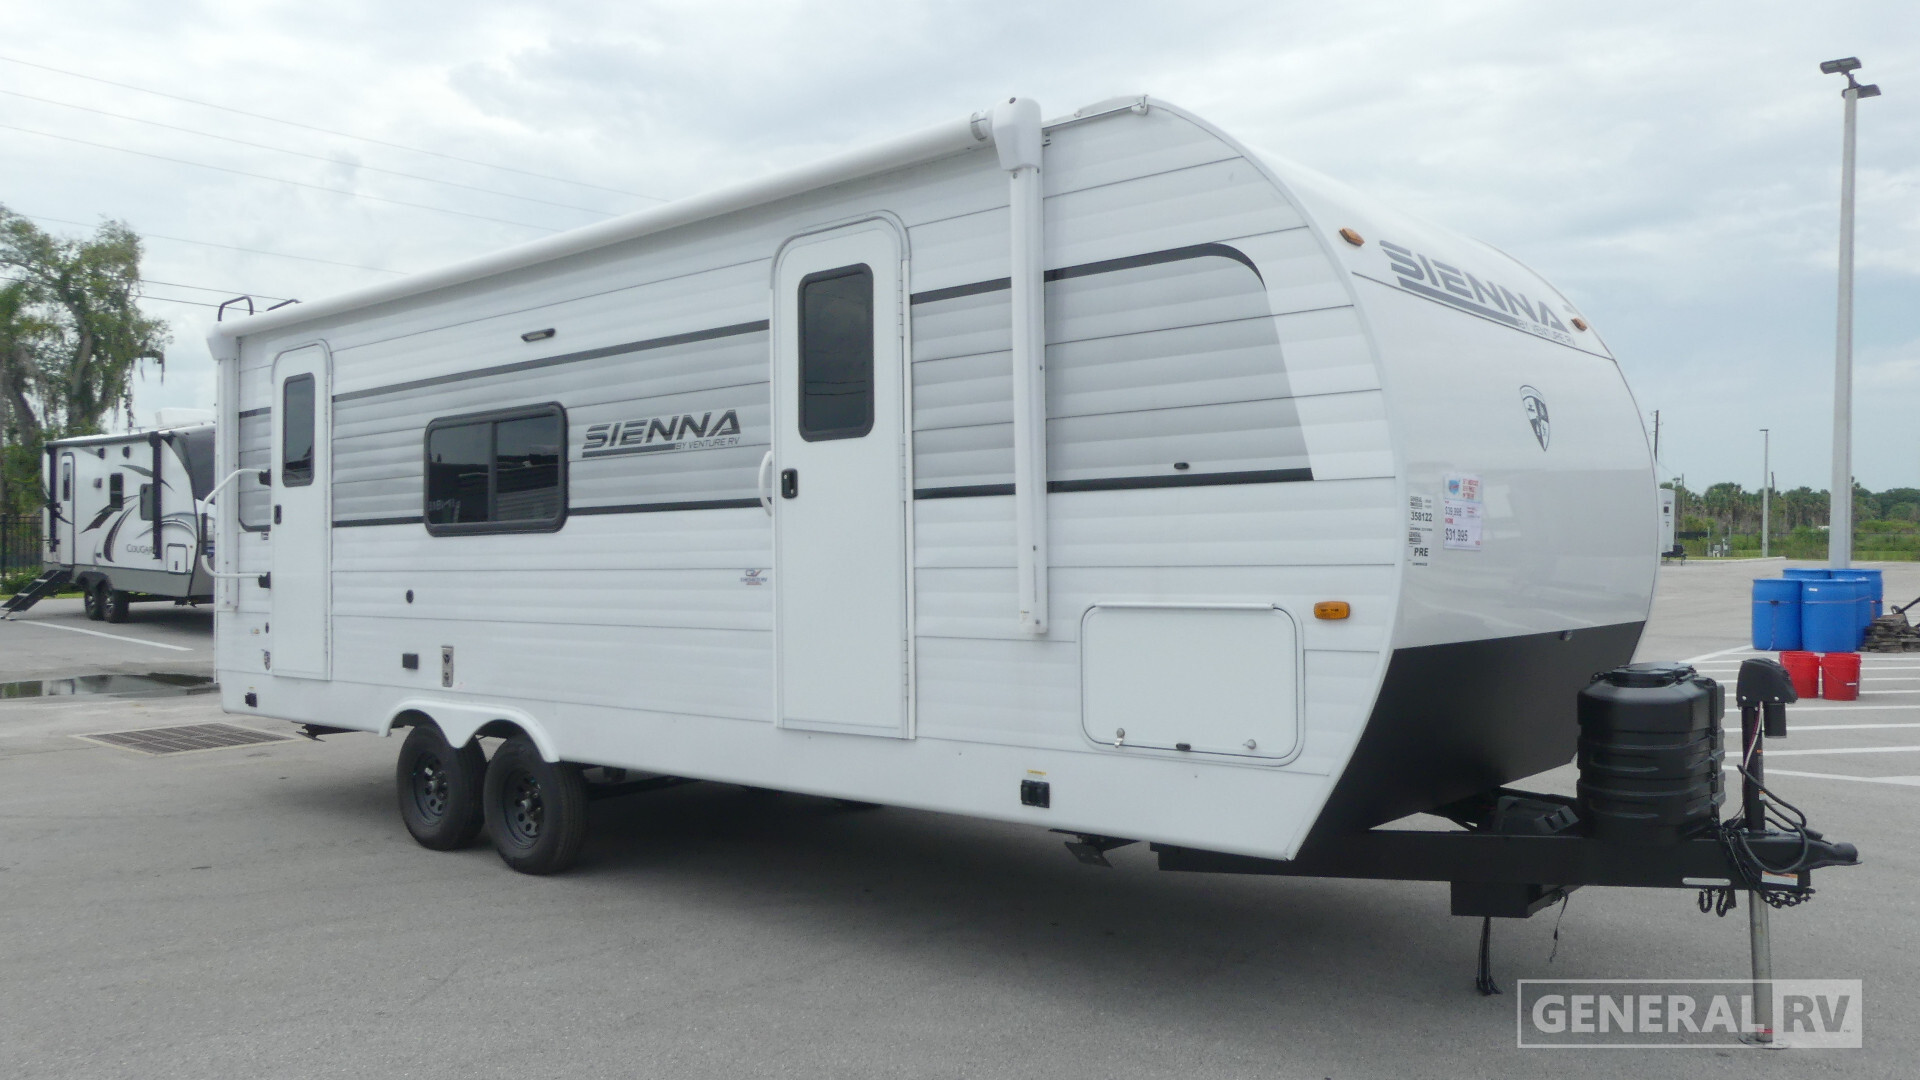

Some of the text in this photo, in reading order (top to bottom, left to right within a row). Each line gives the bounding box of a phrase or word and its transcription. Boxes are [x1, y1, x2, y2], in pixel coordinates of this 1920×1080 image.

[1379, 240, 1570, 334] SIENNA
[582, 409, 741, 449] SIENNA
[675, 437, 740, 450] BY VENTURE RV
[1410, 511, 1432, 522] 358122
[1445, 528, 1468, 542] $31,995
[1414, 547, 1429, 557] PRE
